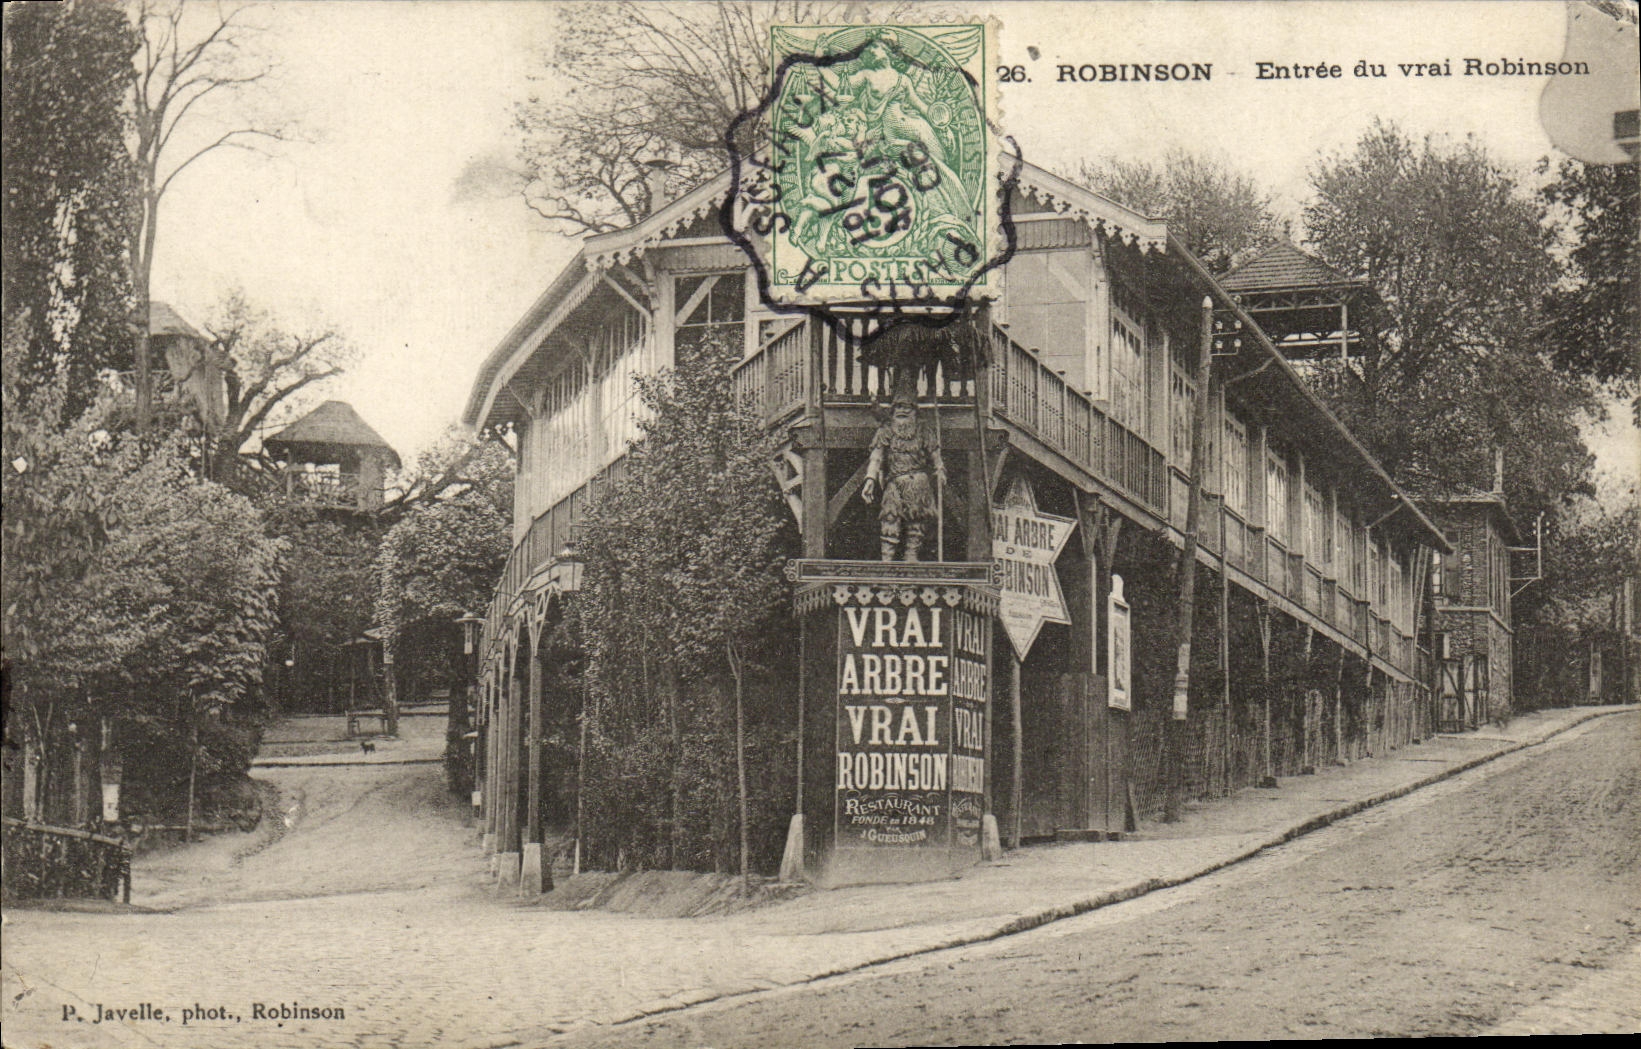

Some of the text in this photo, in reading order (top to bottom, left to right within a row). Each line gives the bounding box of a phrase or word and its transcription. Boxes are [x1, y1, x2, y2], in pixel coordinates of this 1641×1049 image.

[833, 259, 926, 282] POSTES
[1014, 517, 1055, 551] ARBRE
[844, 607, 943, 648] VRAI
[956, 610, 985, 656] VRAI
[839, 653, 949, 695] ARBRE
[952, 657, 986, 702] ARBRE
[845, 705, 939, 745] VRAI
[955, 707, 984, 751] VRAI
[837, 752, 948, 791] ROBINSON
[902, 816, 935, 825] 1848
